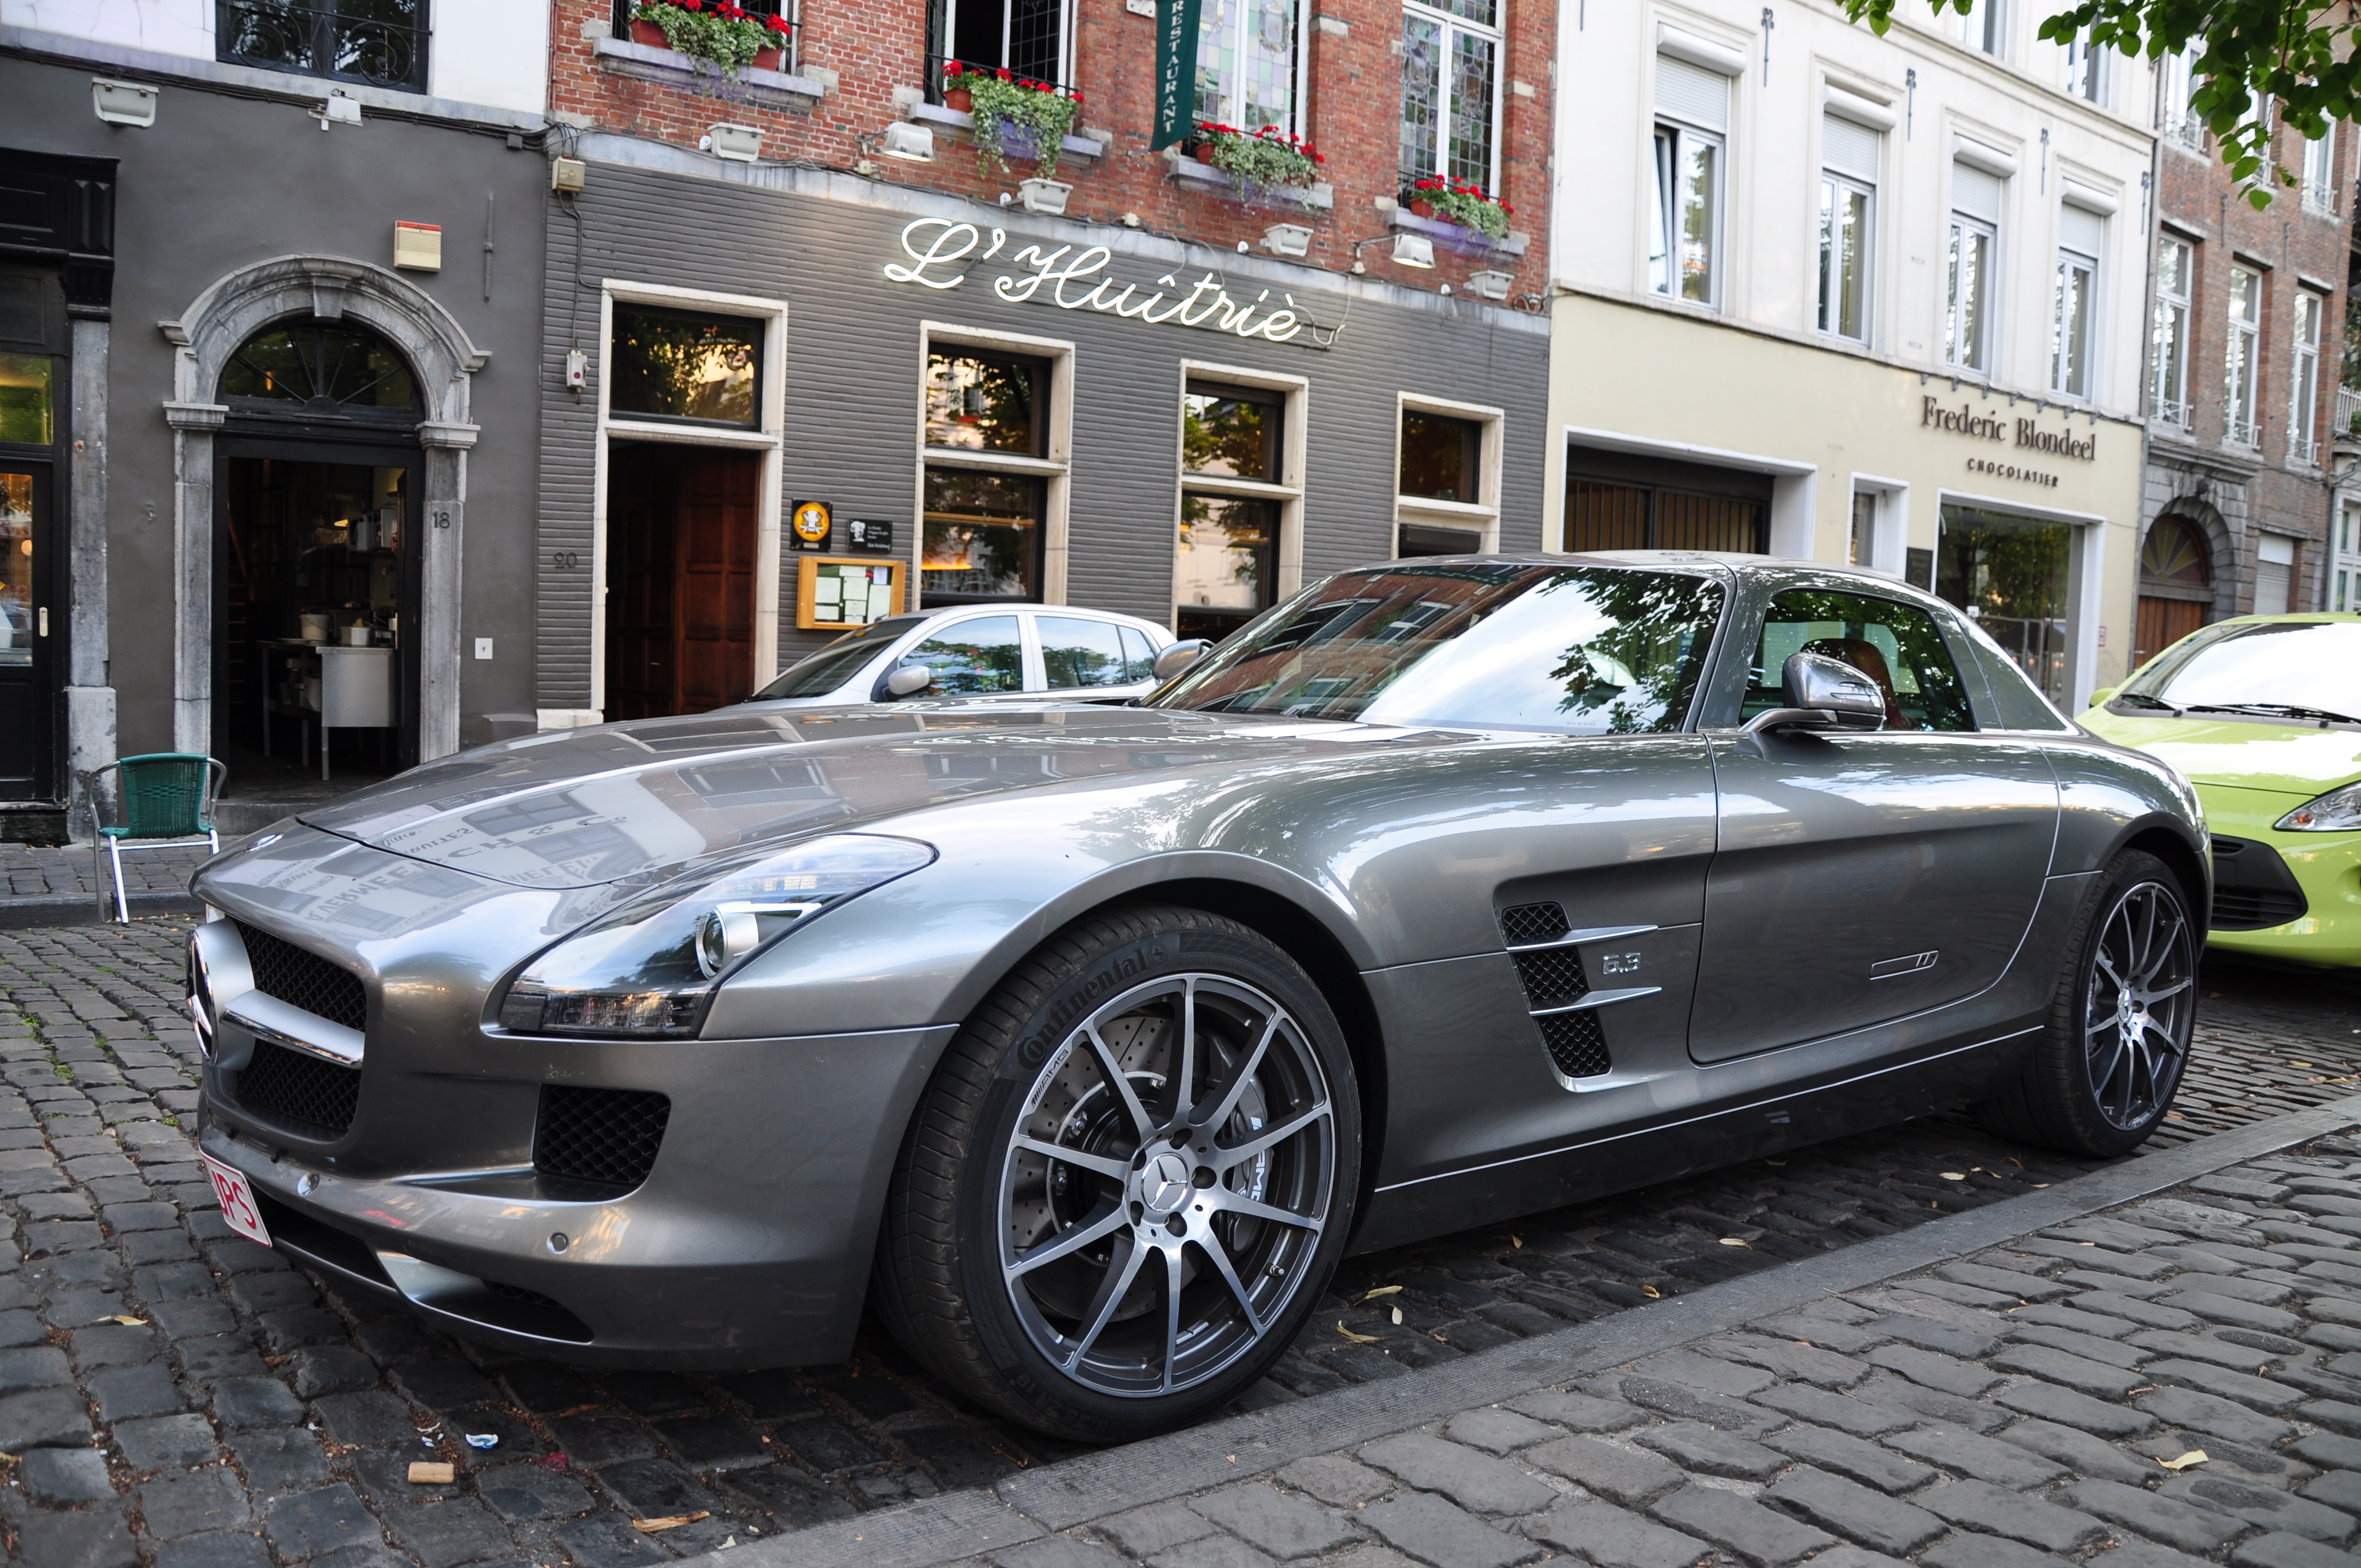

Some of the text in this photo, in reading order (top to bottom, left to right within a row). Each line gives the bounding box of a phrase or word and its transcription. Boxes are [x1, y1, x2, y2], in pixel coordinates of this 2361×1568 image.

[1162, 0, 1184, 133] RESTAURANT
[1921, 395, 2096, 461] Frederic Blondeel
[1967, 458, 2059, 488] CHOCOLATIER
[433, 511, 450, 529] 18
[554, 552, 577, 569] 20
[1602, 952, 1641, 975] 6.3
[1017, 948, 1149, 1070] Continental
[1041, 1048, 1069, 1090] AMG
